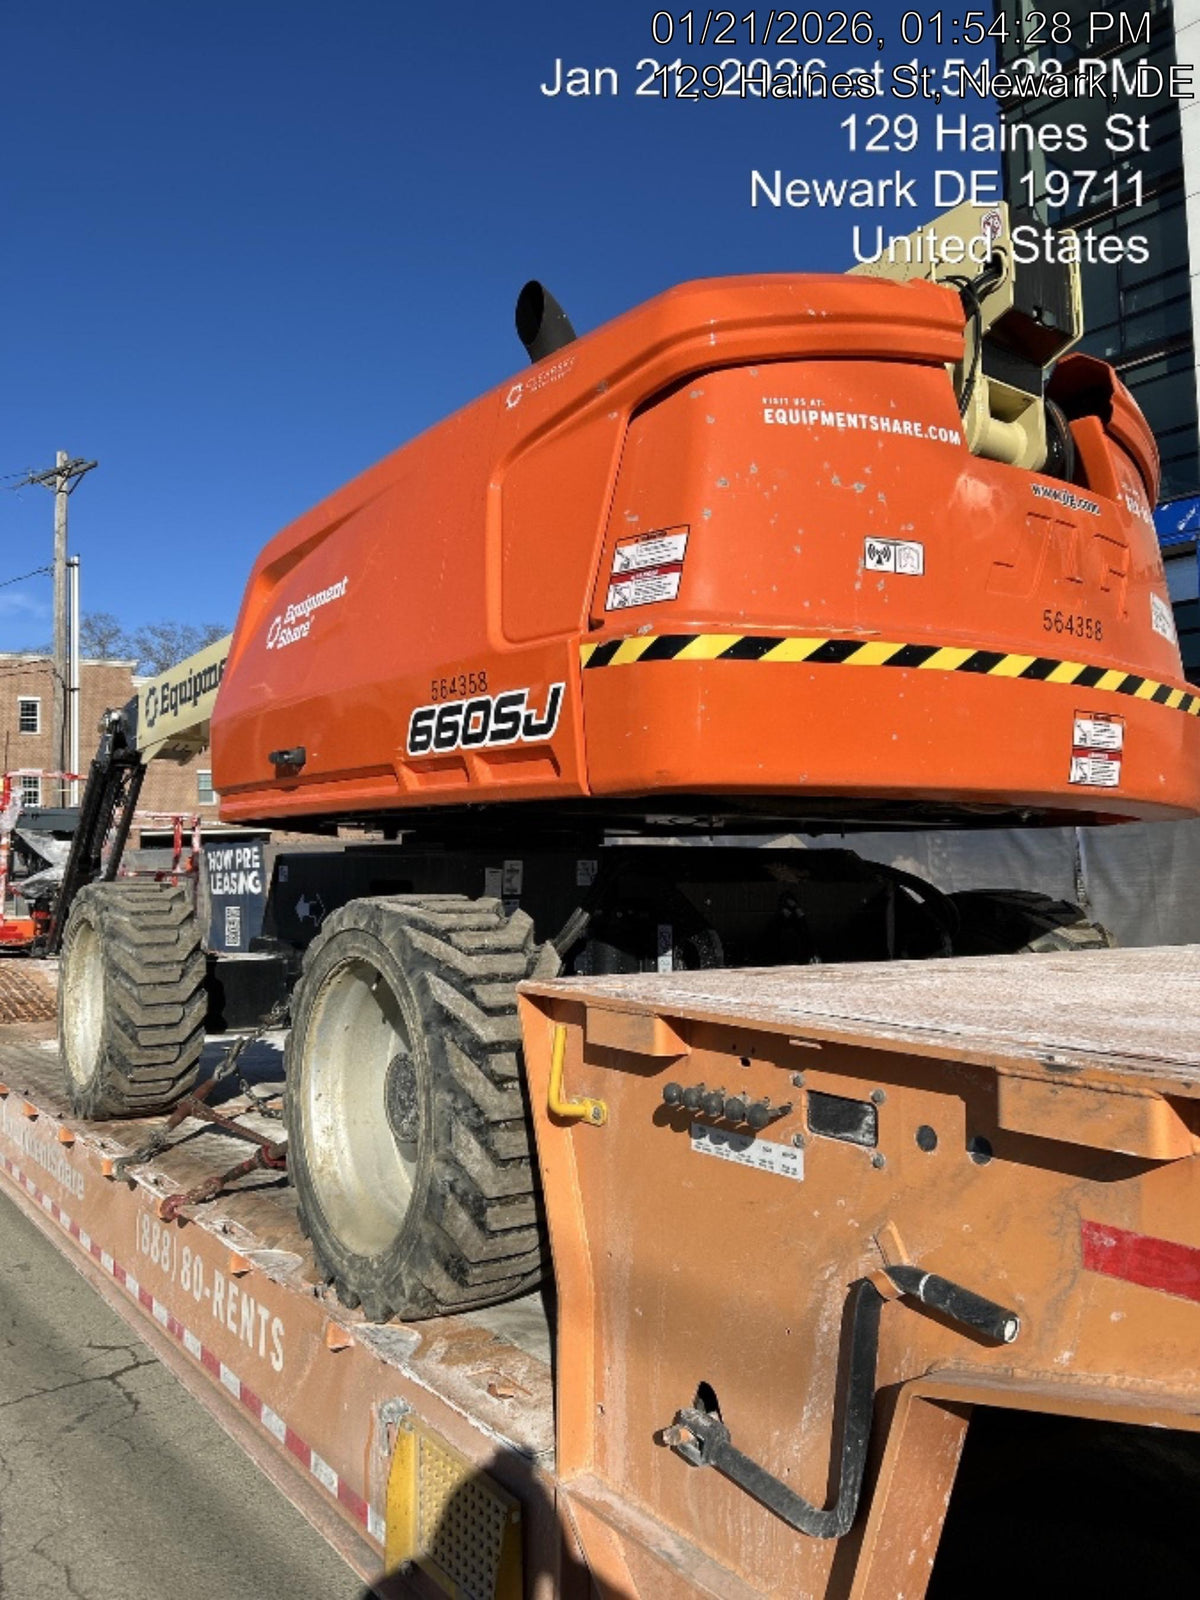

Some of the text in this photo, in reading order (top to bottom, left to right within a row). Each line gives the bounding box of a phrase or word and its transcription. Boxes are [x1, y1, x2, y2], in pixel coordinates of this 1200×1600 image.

[763, 408, 961, 446] EQUIPMENTSHARE.COM
[284, 575, 349, 625] Equipment
[277, 621, 311, 650] Share
[1043, 609, 1104, 642] 564358
[431, 671, 488, 701] 564358
[407, 682, 566, 756] 660SJ
[236, 846, 261, 871] PRE
[211, 870, 262, 896] LEASING
[136, 1208, 285, 1373] (888) 80-RENTS
